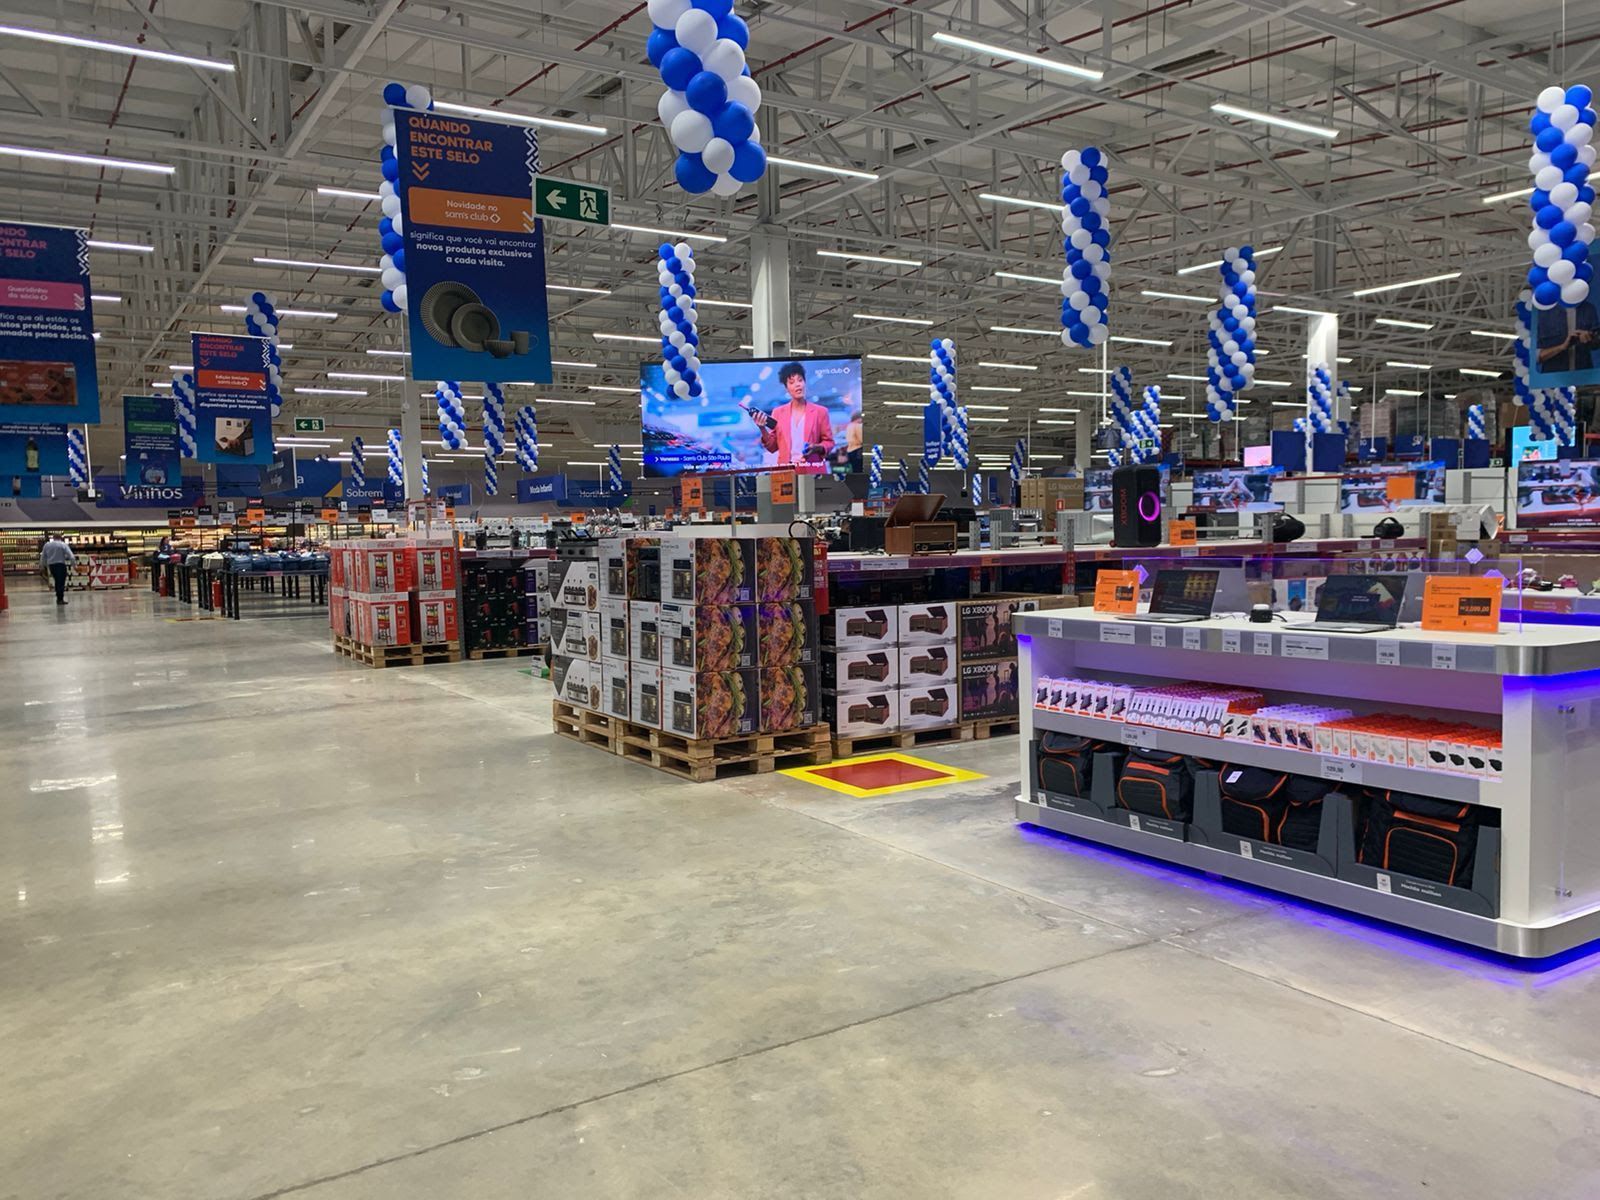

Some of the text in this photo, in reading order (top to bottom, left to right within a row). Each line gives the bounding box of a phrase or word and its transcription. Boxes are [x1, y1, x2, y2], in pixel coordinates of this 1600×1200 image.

[409, 116, 471, 135] QUANDO
[409, 131, 493, 152] ENCONTRAR
[410, 145, 480, 164] ESTE SELO
[446, 199, 498, 212] Novidade no
[445, 209, 489, 222] sam's club
[410, 230, 537, 248] significa que você vai encontrar
[5, 248, 36, 259] SELO
[416, 242, 532, 259] novos produtos exclusivos
[454, 256, 477, 265] cada
[478, 257, 506, 267] visita.
[16, 314, 32, 322] que
[46, 315, 67, 323] estão
[35, 331, 58, 339] pelos
[60, 331, 89, 340] sócios.
[199, 343, 245, 352] ENCONTRAR
[830, 367, 843, 375] club
[119, 484, 184, 500] Vinhos
[962, 604, 996, 615] LG XBOOM
[962, 664, 997, 674] LG XBOOM
